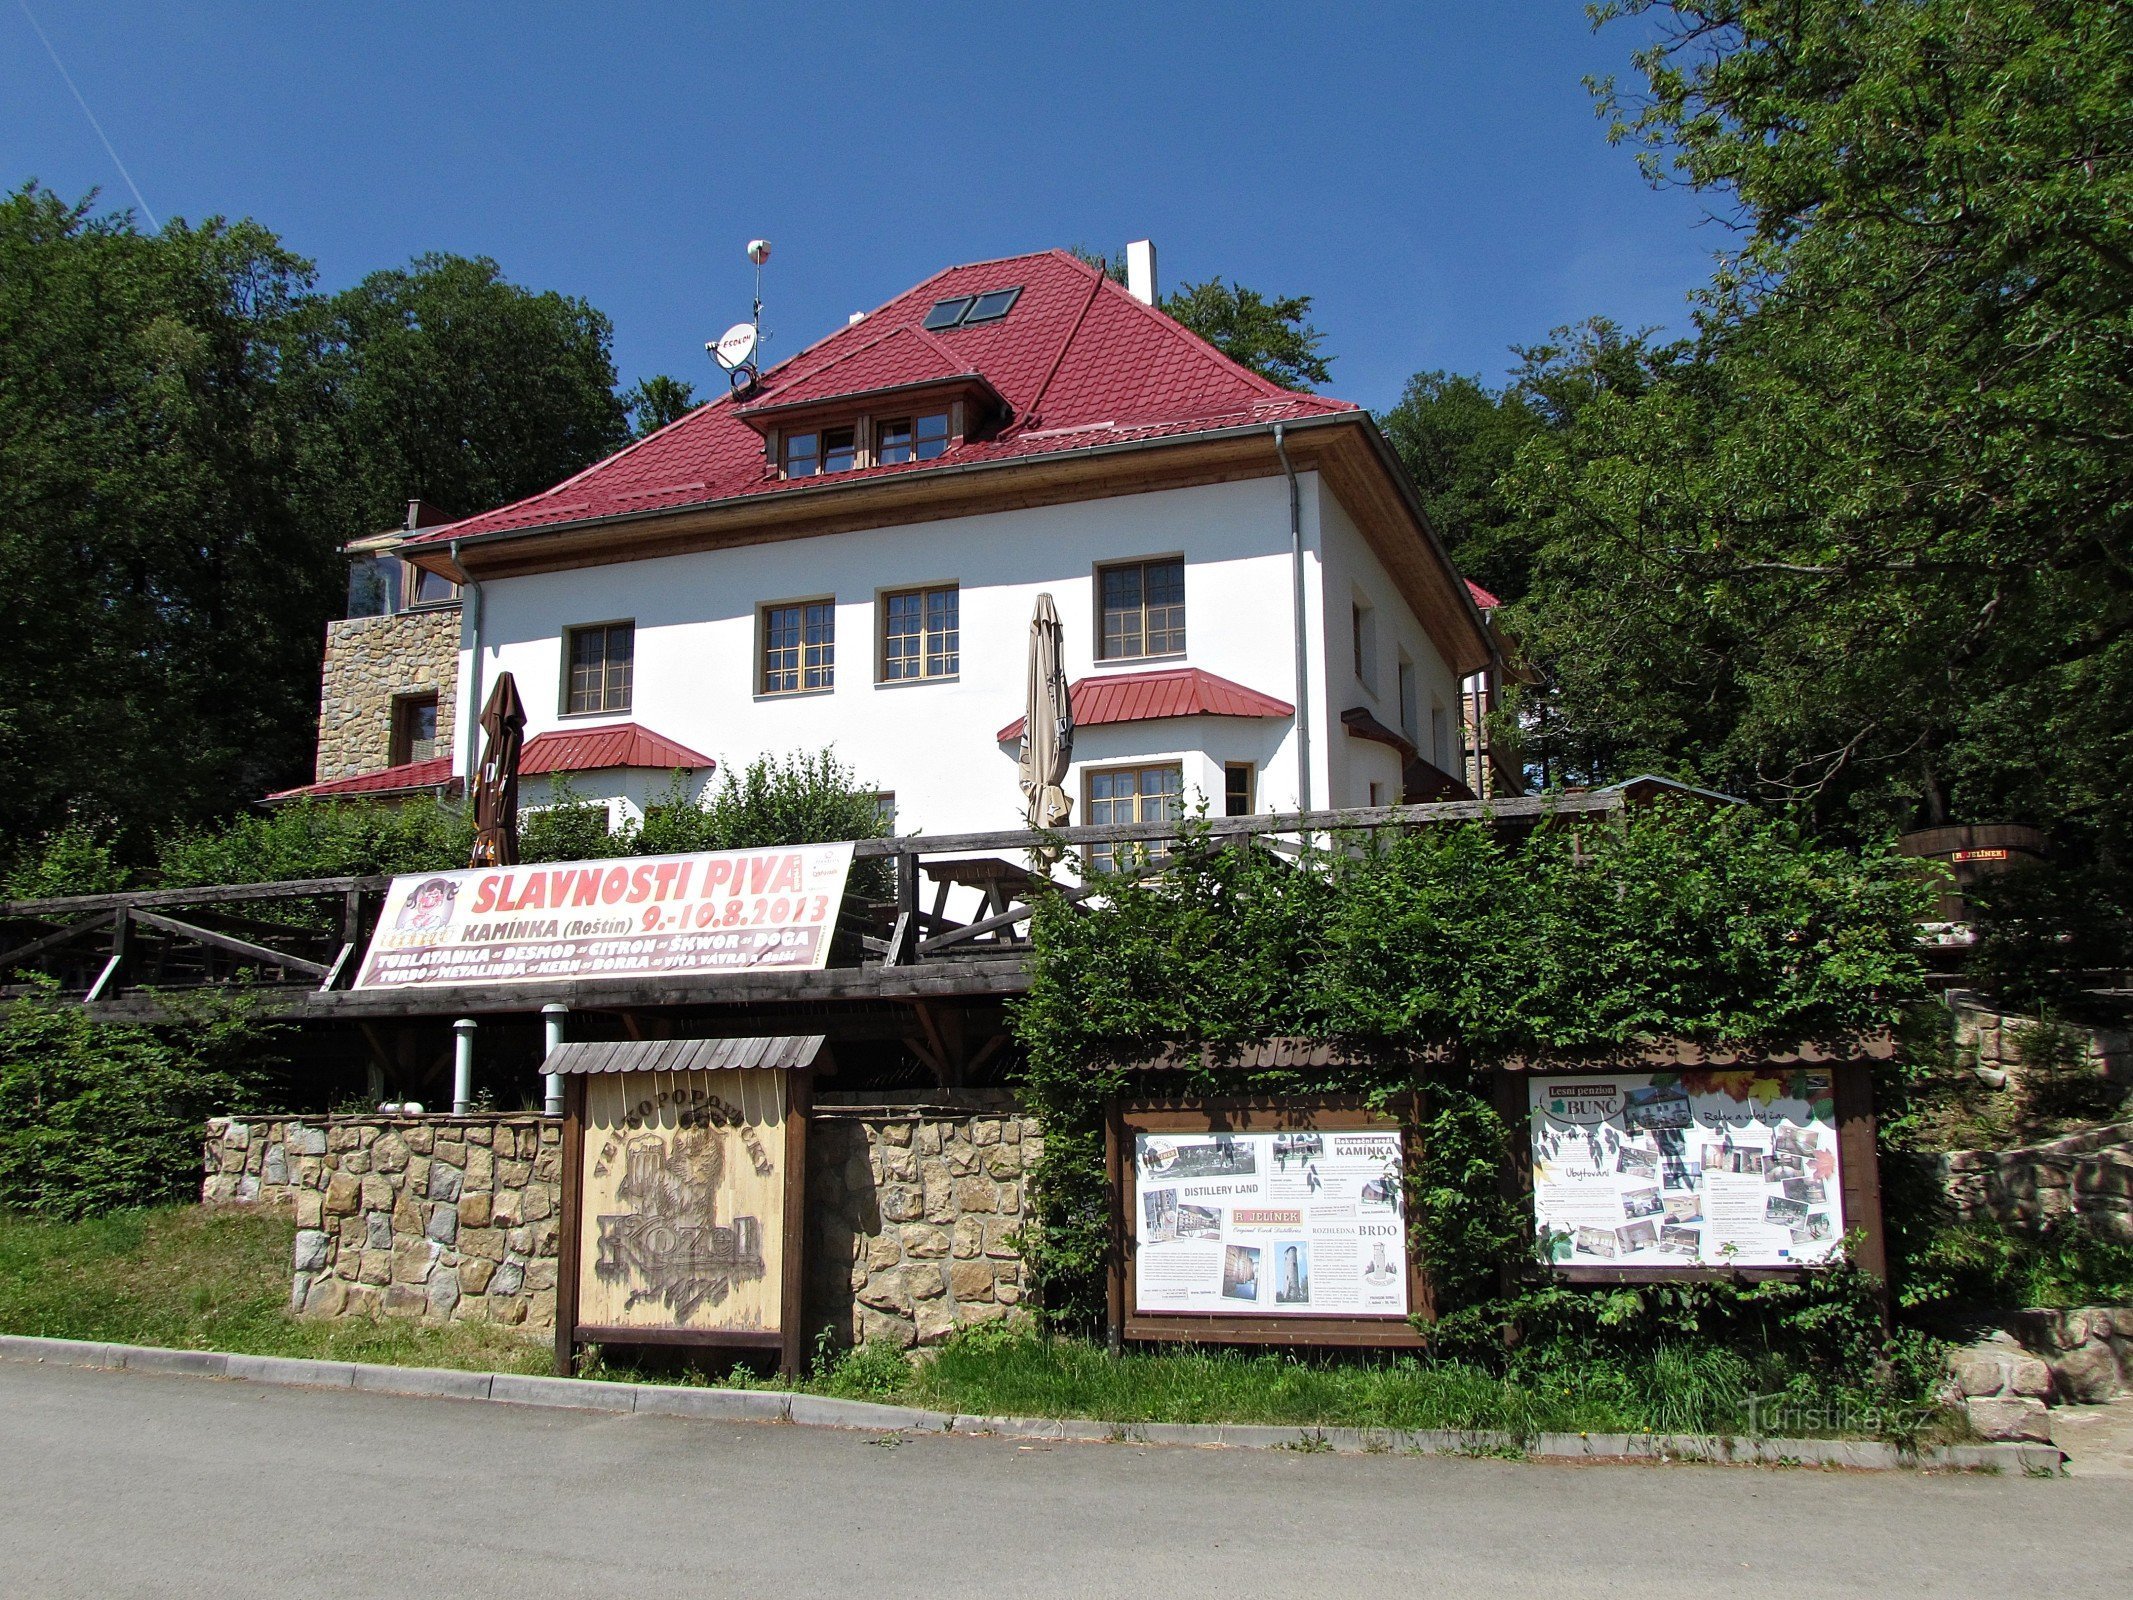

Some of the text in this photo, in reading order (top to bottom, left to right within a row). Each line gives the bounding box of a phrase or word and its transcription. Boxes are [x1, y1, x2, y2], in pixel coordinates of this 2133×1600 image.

[1966, 849, 2002, 858] JELÍNEK
[472, 854, 793, 913] SLAVNOSTI PIVA
[641, 895, 829, 932] 9.-10.8.2013
[461, 917, 633, 942] KAMÍNKA (Roštín)
[377, 931, 809, 968] TUBLATANKA DESMOD CITRON ŠKWOR DOGA
[380, 967, 428, 983] TURBO
[436, 961, 527, 979] METALINDA
[536, 959, 581, 974] KERN
[590, 955, 650, 971] BORRA
[700, 951, 747, 966] VÁVRA
[762, 949, 797, 963] další
[1577, 1085, 1614, 1097] penzion
[1567, 1097, 1617, 1114] BUNČ
[1704, 1112, 1732, 1121] Relax
[1745, 1112, 1767, 1124] volný
[1769, 1111, 1787, 1120] čas
[1335, 1137, 1373, 1145] Rekreační
[1336, 1145, 1393, 1155] KAMÍNKA
[1565, 1167, 1610, 1181] Ubytování
[1184, 1184, 1258, 1196] DISTILLERY LAND
[1250, 1211, 1298, 1221] JELÍNEK
[1233, 1226, 1254, 1234] Original
[1358, 1225, 1397, 1236] BRDO
[597, 1214, 762, 1270] Kozel
